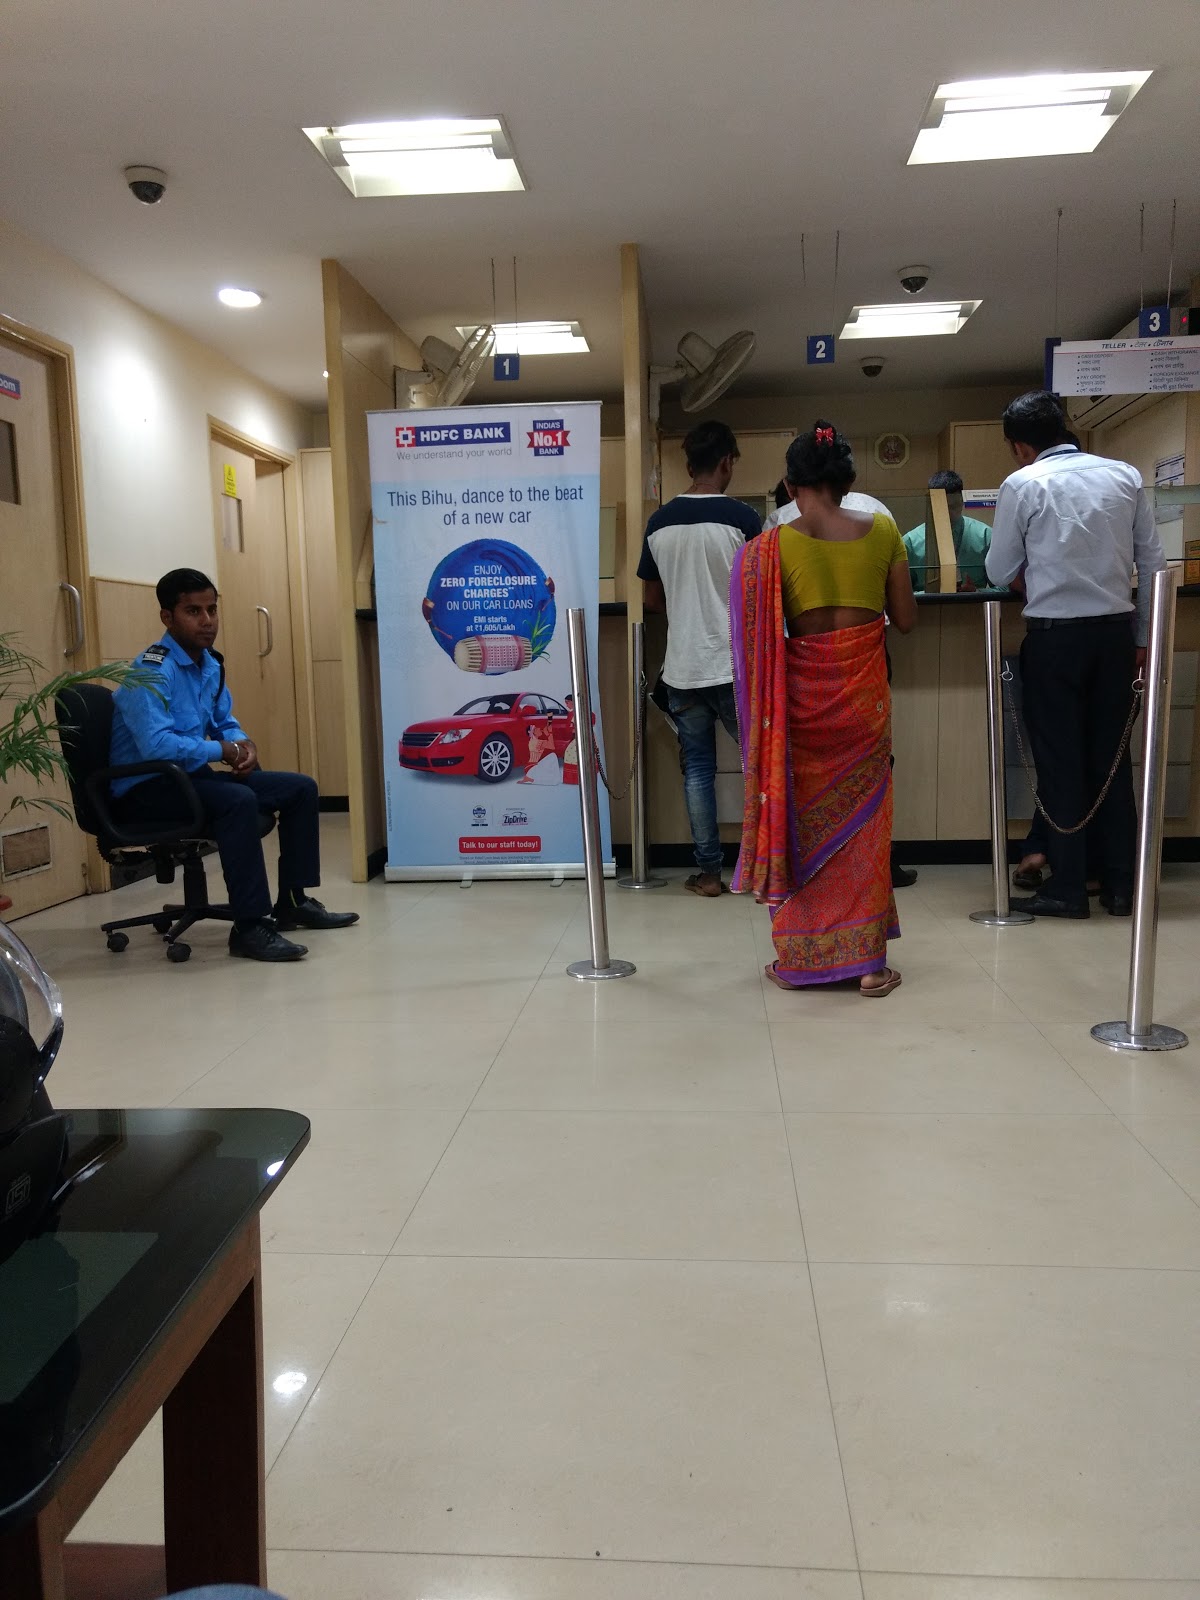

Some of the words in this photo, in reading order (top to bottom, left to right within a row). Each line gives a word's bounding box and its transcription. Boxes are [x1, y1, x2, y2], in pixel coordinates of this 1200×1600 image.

[1149, 312, 1161, 332] 3
[816, 340, 826, 359] 2
[503, 358, 510, 375] 1
[536, 422, 561, 430] INDIA'S
[420, 429, 459, 442] HDFC
[463, 427, 505, 440] BANK
[533, 431, 562, 447] No.1
[396, 451, 411, 460] We
[413, 449, 464, 460] understand
[466, 449, 485, 459] your
[488, 447, 512, 457] world
[387, 491, 417, 507] This
[421, 489, 457, 507] Bihu,
[462, 489, 504, 504] dance
[509, 487, 523, 502] to
[527, 486, 550, 502] the
[555, 485, 584, 501] beat
[443, 510, 457, 526] of
[461, 512, 471, 525] a
[475, 511, 504, 525] new
[509, 510, 532, 524] car
[474, 565, 503, 576] ENJOY
[440, 577, 466, 588] ZERO
[468, 575, 537, 587] FORECLOSURE
[446, 601, 460, 611] ON
[462, 600, 481, 611] OUR
[484, 600, 501, 610] CAR
[503, 599, 534, 610] LOANS
[473, 615, 487, 624] EMI
[487, 615, 508, 623] starts
[462, 841, 477, 849] Talk
[478, 841, 485, 849] to
[517, 840, 539, 849] today!
